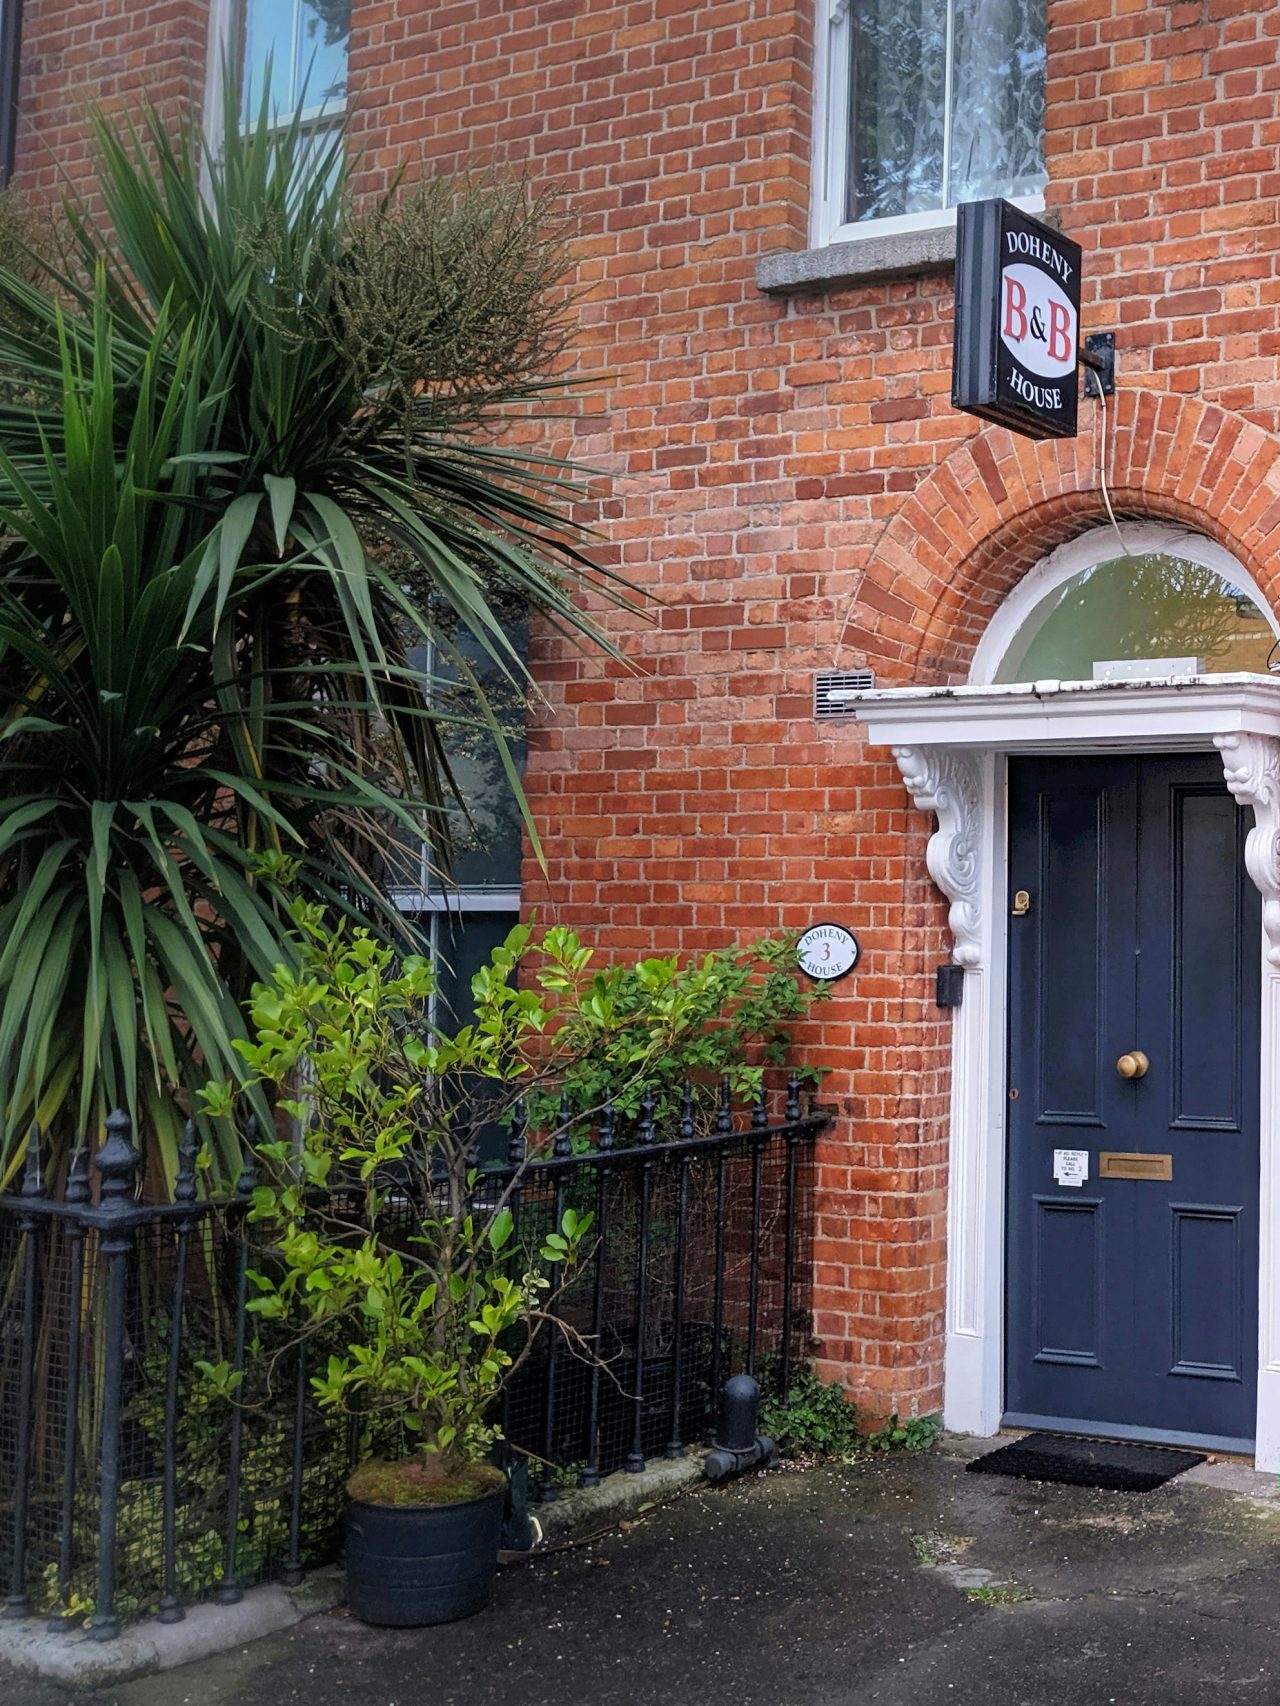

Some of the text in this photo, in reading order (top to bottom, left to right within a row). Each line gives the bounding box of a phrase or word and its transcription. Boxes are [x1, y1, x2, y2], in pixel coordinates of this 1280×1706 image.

[1006, 231, 1073, 284] DOHENY
[1003, 275, 1071, 362] B&B
[1010, 368, 1062, 409] HOUSE
[804, 928, 849, 946] DOHENY
[820, 942, 831, 961] 3
[807, 961, 843, 976] HOUSE
